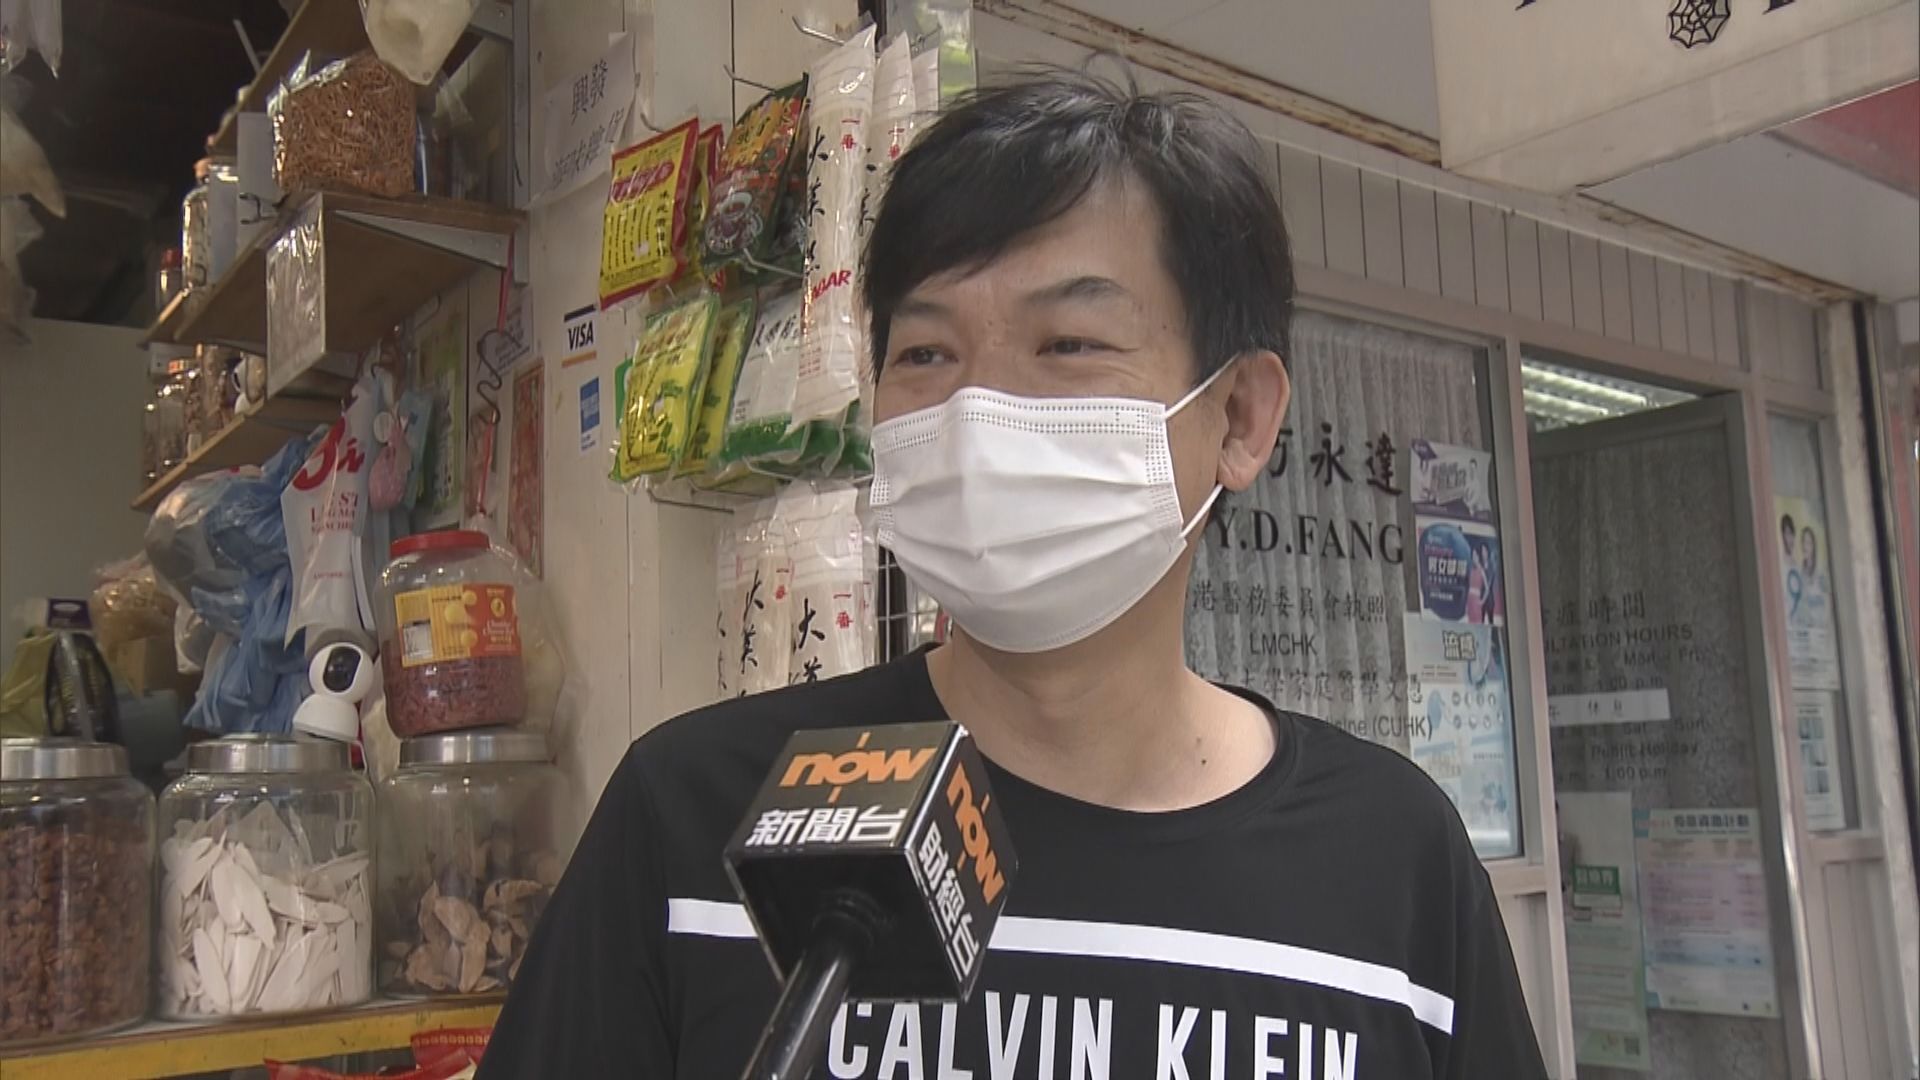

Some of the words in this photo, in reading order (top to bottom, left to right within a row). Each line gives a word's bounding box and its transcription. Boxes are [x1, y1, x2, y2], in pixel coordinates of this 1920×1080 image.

[567, 320, 595, 351] VISA
[1215, 508, 1404, 565] Y.D.FANG
[1249, 632, 1318, 657] LMCHK
[1625, 622, 1694, 646] HOURS
[1372, 714, 1434, 744] (CUHK)
[779, 741, 938, 797] now
[744, 804, 908, 848] 新聞台
[946, 762, 1005, 905] now
[917, 820, 981, 983] 財經台
[827, 990, 1114, 1080] CALVIN
[1156, 1002, 1359, 1080] KLEIN
